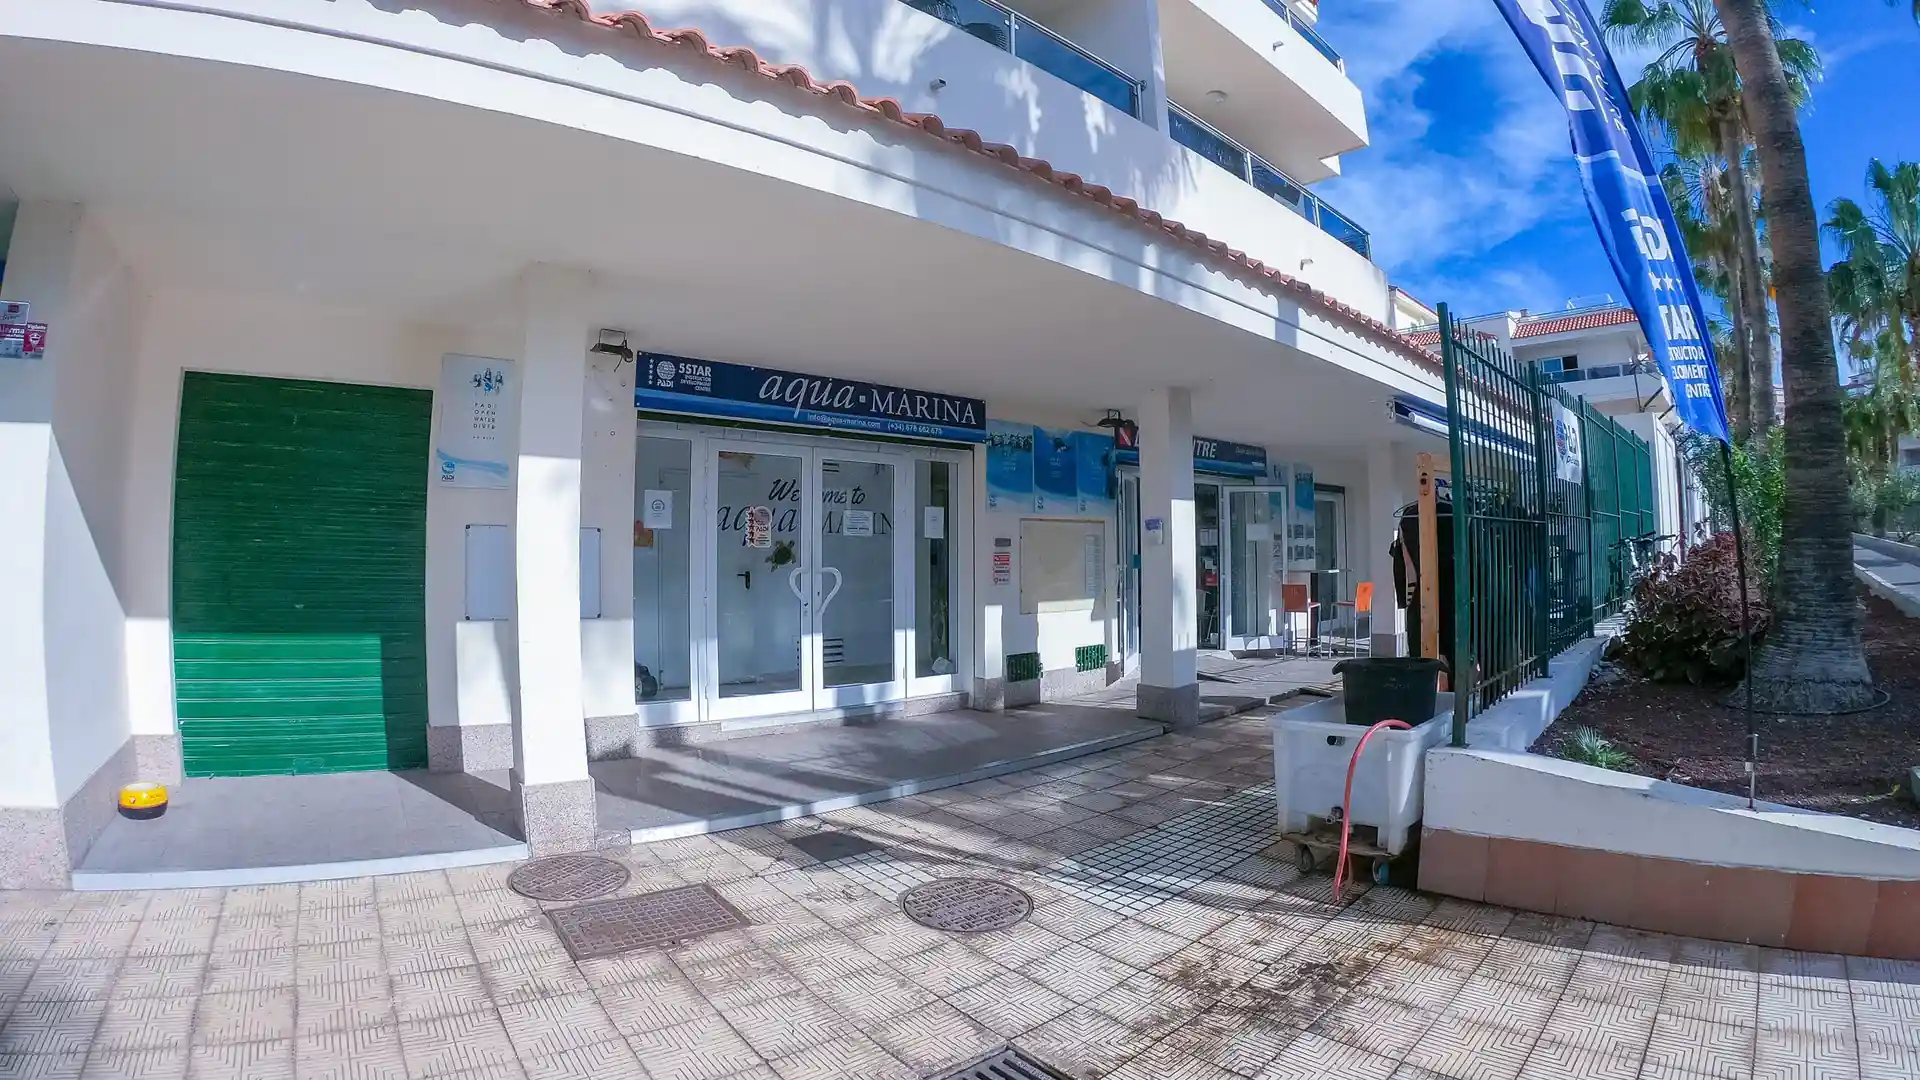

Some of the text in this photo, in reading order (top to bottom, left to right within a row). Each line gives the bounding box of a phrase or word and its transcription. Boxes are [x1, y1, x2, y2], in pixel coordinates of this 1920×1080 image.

[758, 375, 977, 426] aqua MARINA
[1193, 439, 1217, 459] TRE
[851, 484, 866, 505] to
